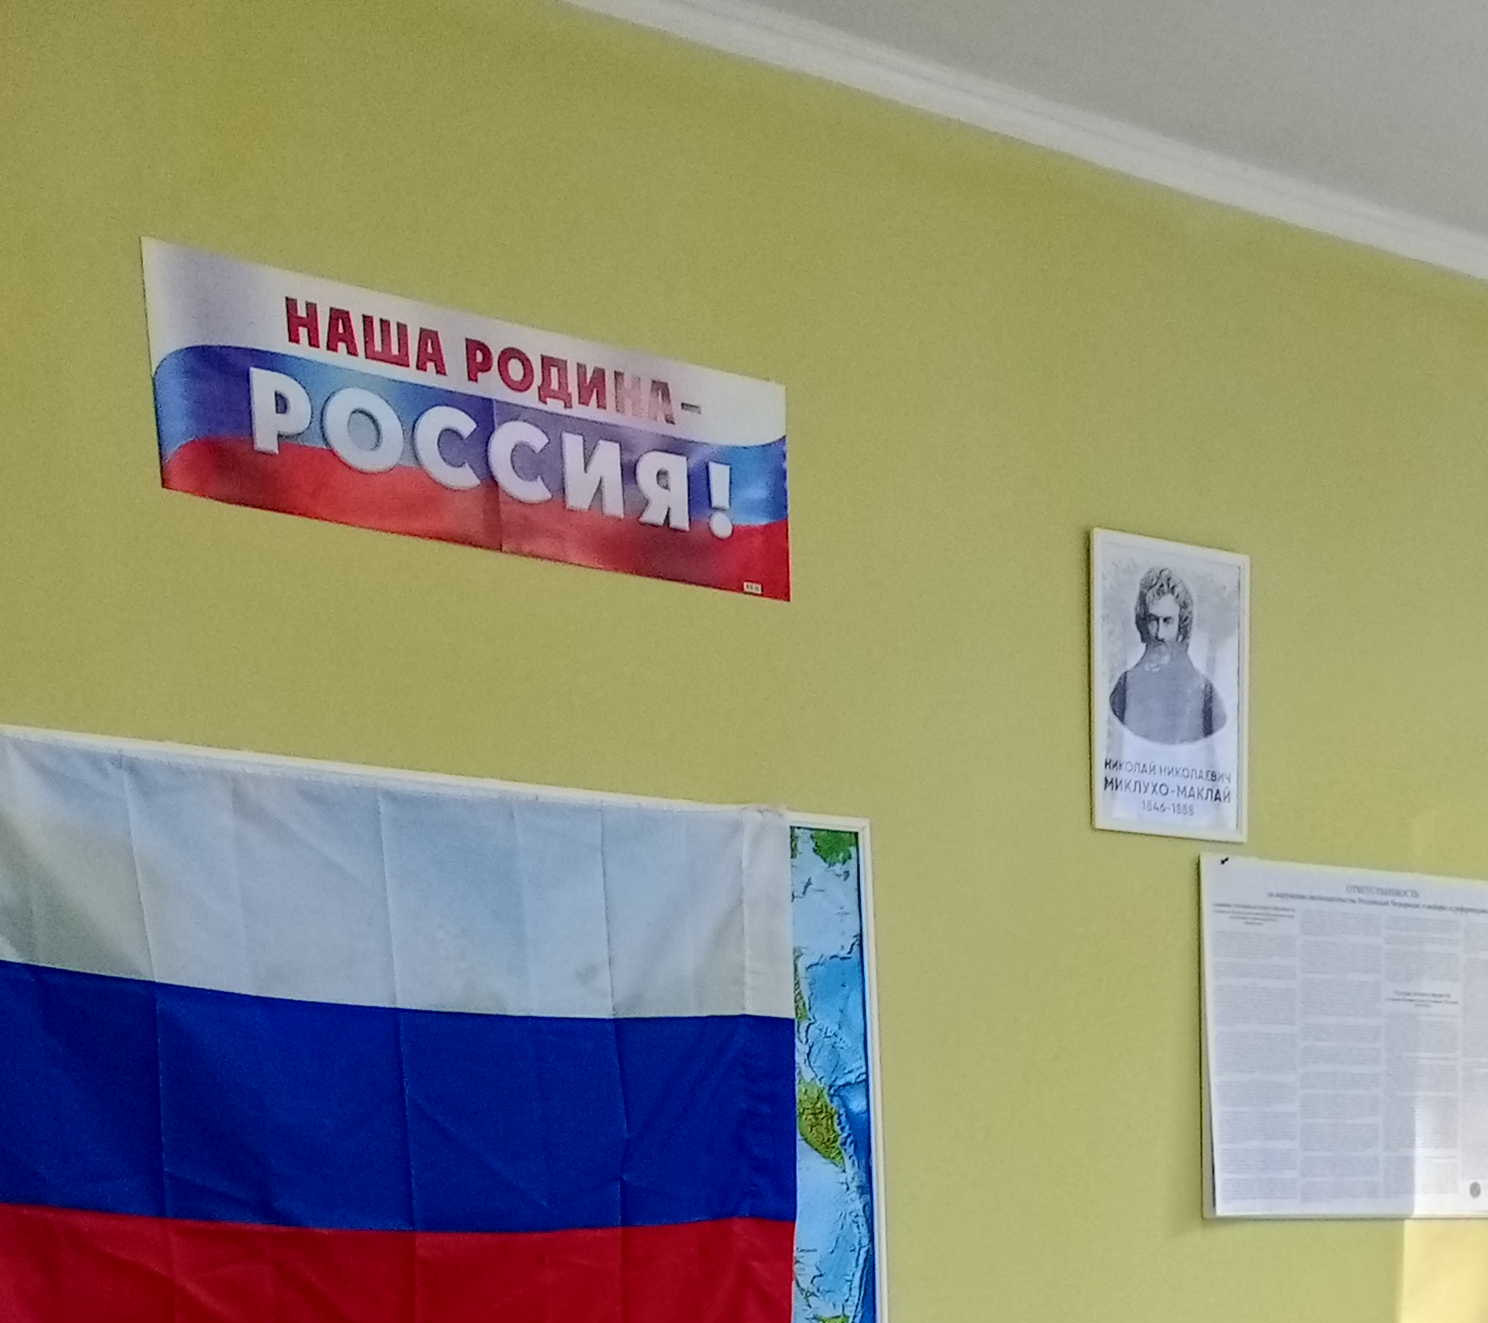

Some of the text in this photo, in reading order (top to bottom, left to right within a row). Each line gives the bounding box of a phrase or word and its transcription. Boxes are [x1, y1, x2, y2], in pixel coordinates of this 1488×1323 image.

[284, 297, 448, 376] НАША
[248, 366, 735, 540] РОССИЯ!
[1104, 758, 1232, 783] НИКОЛАЙ НИКОЛАЕВИЧ
[1104, 776, 1232, 803] МИКЛУХО-МАКЛАЙ
